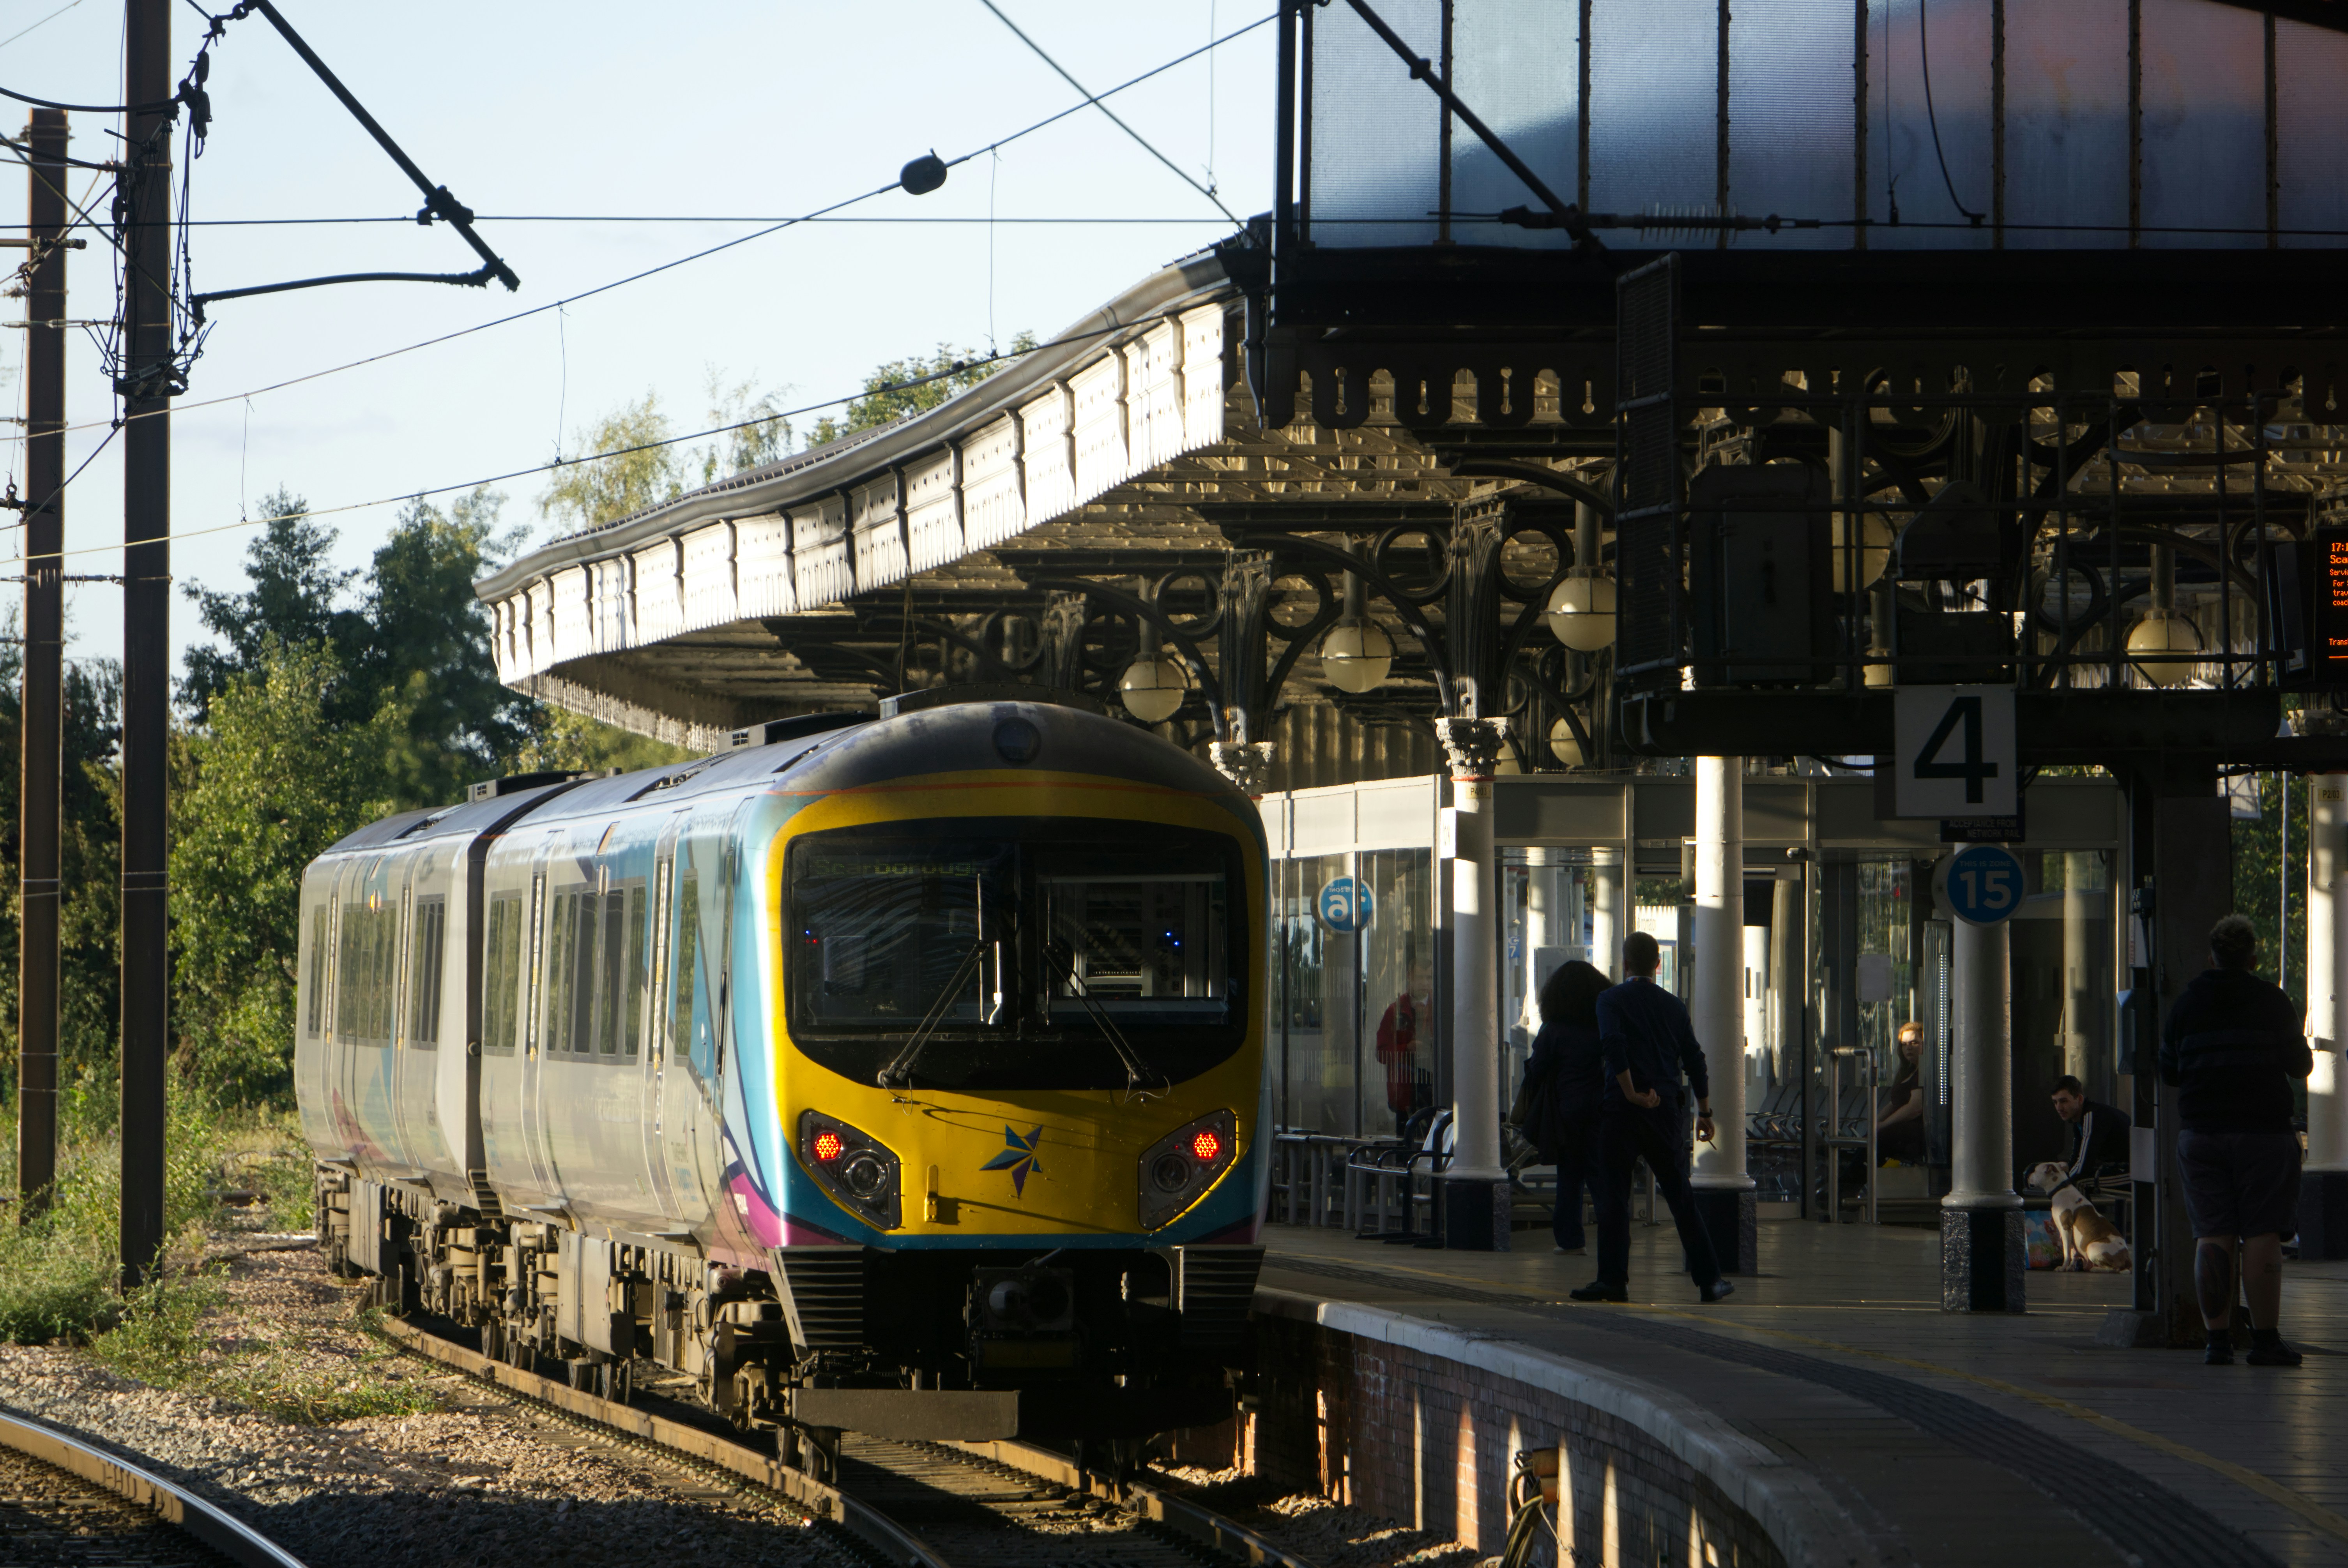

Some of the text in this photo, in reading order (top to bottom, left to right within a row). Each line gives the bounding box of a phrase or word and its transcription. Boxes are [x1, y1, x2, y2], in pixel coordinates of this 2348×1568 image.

[2330, 555, 2348, 563] Sca
[1914, 696, 1998, 803] 4
[2323, 790, 2339, 798] P2/03
[1997, 819, 2016, 828] FROM
[1967, 829, 2021, 838] NETWORK RAIL
[1959, 870, 2012, 909] 15
